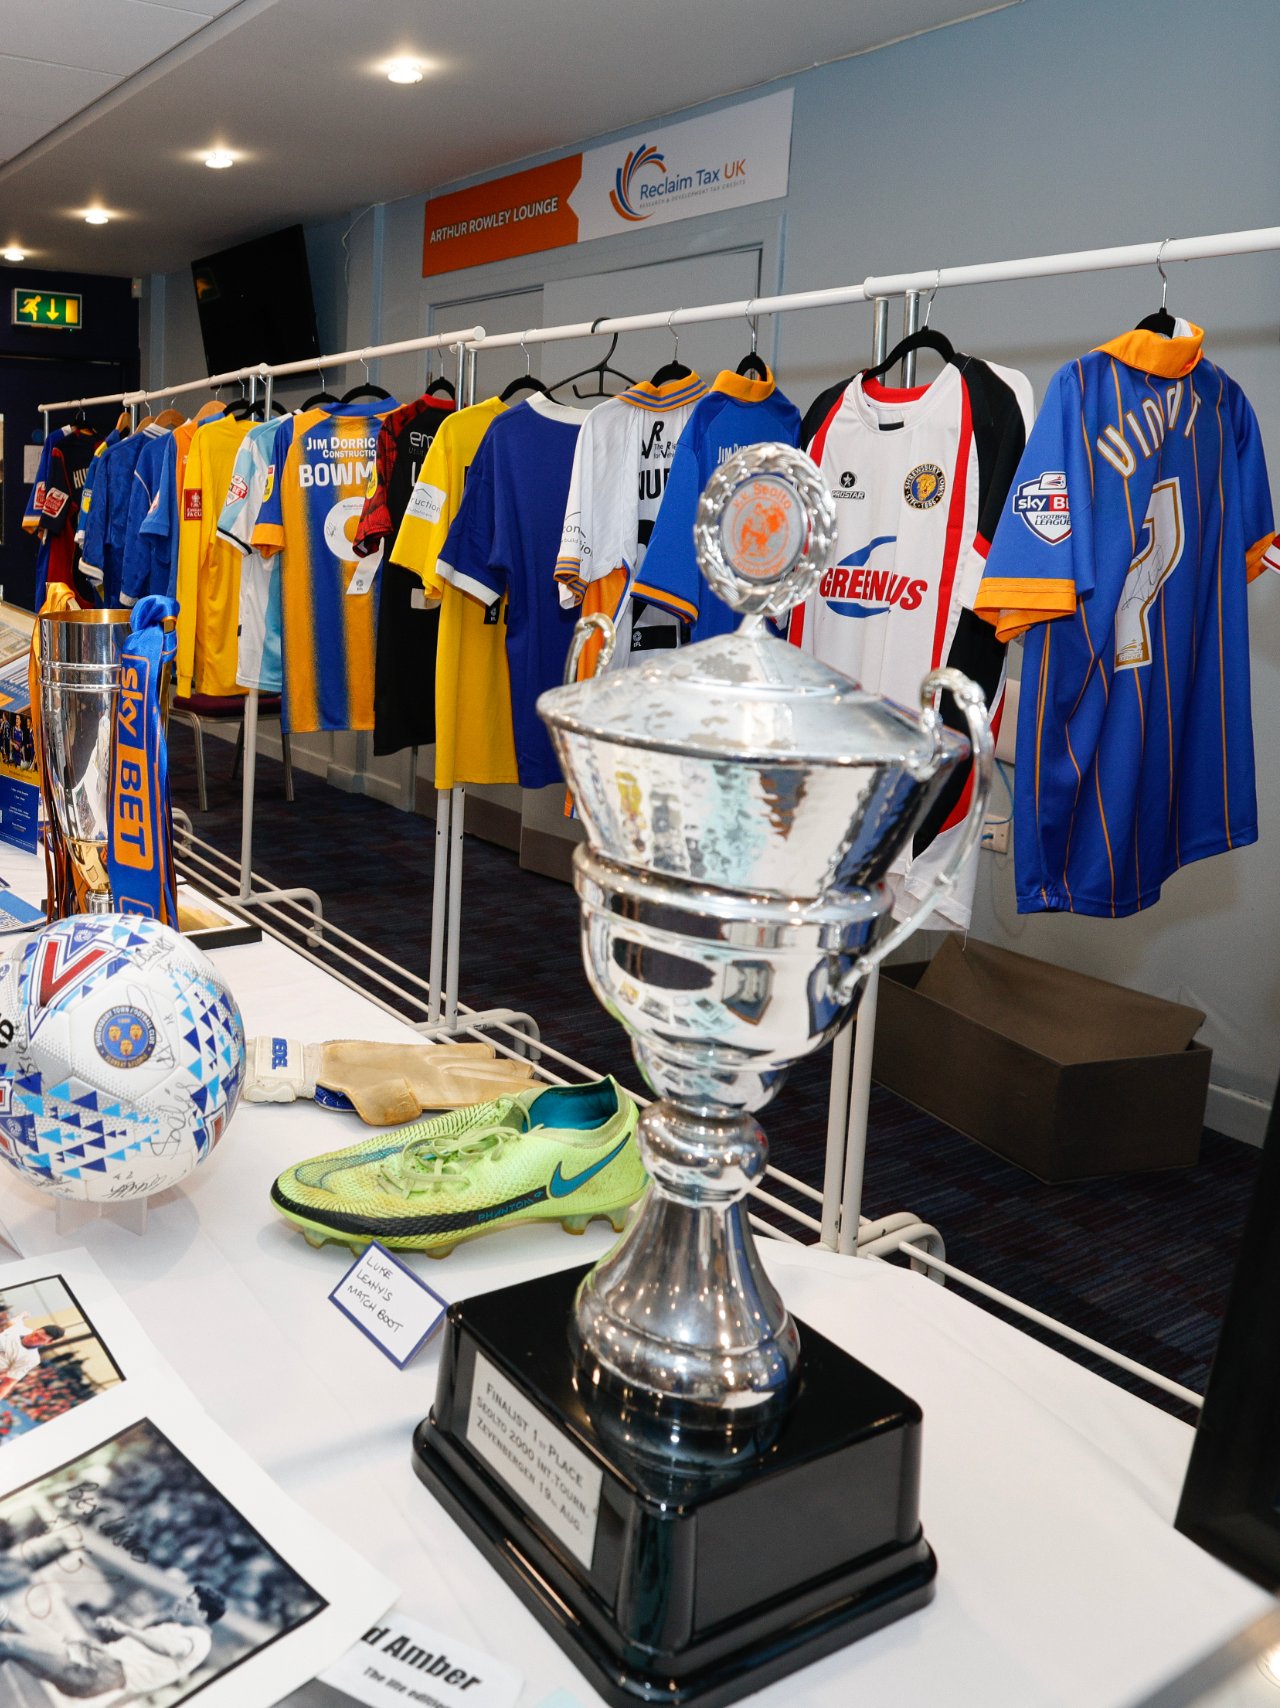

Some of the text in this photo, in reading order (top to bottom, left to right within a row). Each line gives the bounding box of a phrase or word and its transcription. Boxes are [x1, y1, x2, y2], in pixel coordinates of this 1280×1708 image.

[640, 159, 746, 200] Reclaim Tax UK
[430, 197, 559, 243] ARTHUR ROWLEY LOUNGE
[306, 437, 376, 450] JIM DORRIC
[322, 449, 377, 458] CONSTRUCTIO
[409, 431, 434, 449] em
[299, 461, 375, 487] BOWM
[1018, 495, 1047, 511] sky
[118, 666, 144, 738] sky
[119, 758, 148, 858] BET
[478, 1198, 534, 1221] PHANTOM
[366, 1256, 393, 1280] LUKE
[347, 1285, 404, 1333] MATCH BOOT
[477, 1397, 508, 1435] SEOLTO
[509, 1428, 535, 1461] 2000
[486, 1383, 529, 1433] FINALIST
[548, 1444, 584, 1488] PLACE
[476, 1416, 537, 1486] ZEVENBERGEN
[363, 1666, 386, 1682] The
[381, 1635, 483, 1690] Amber
